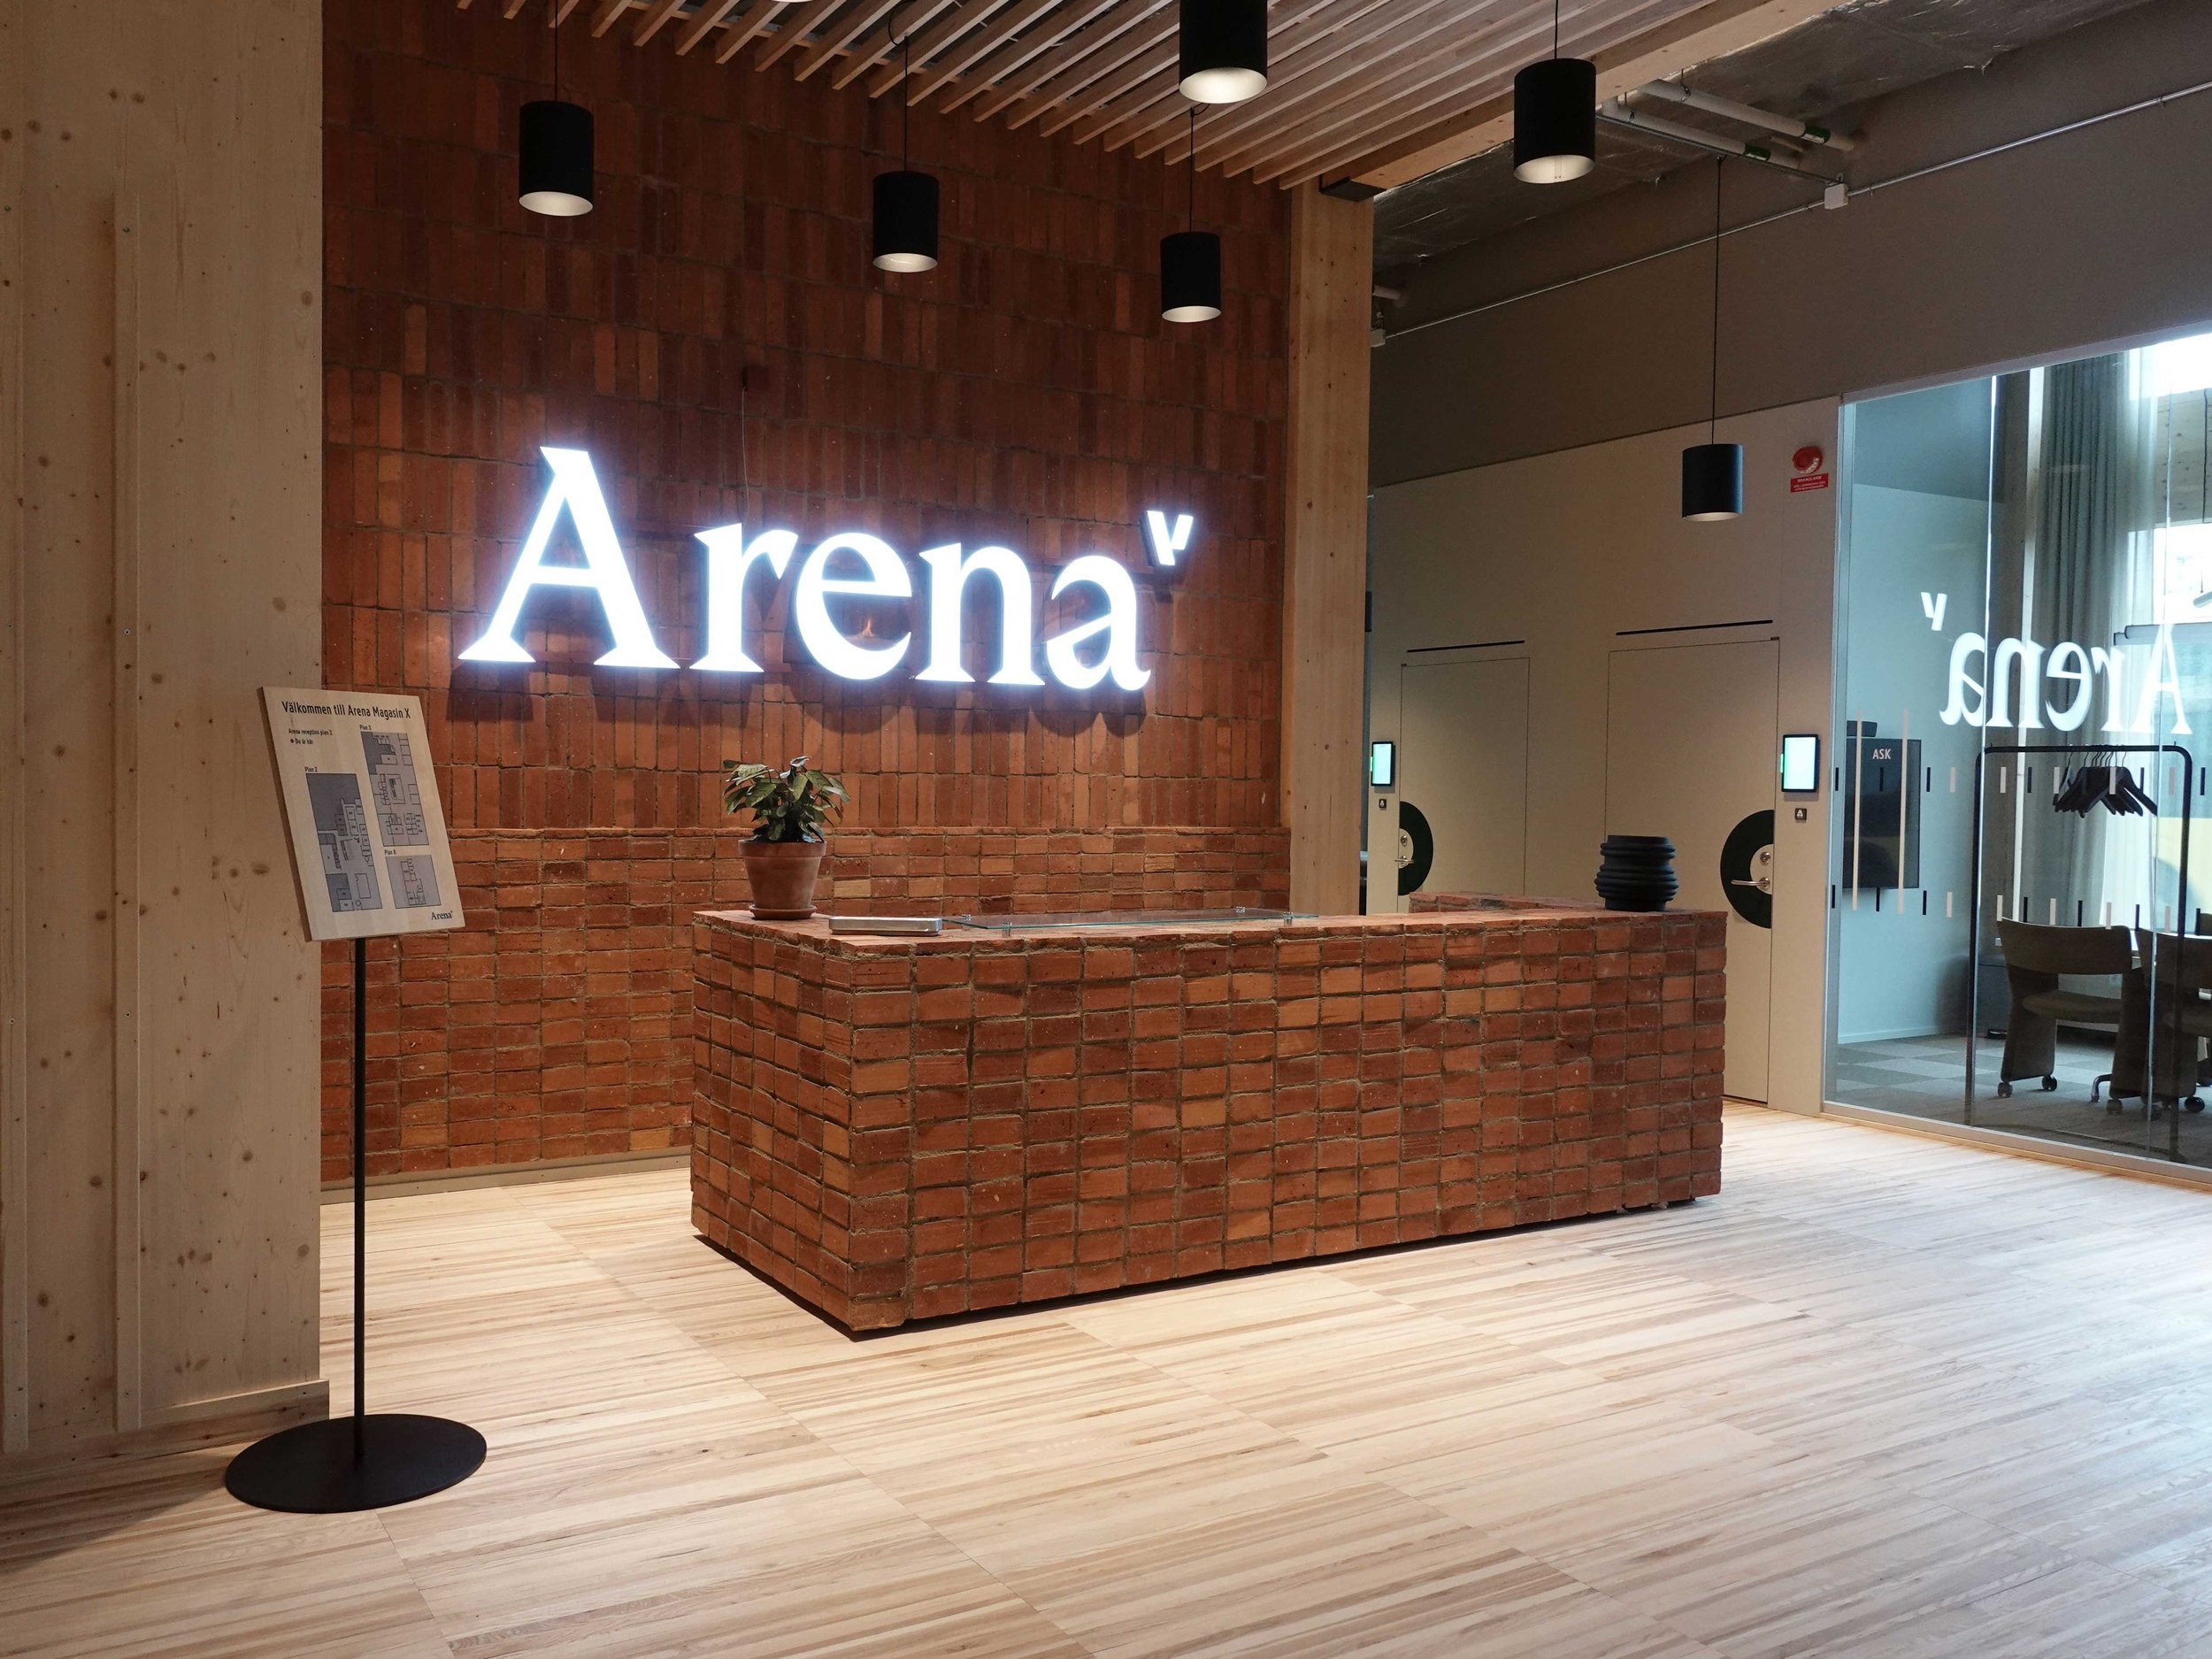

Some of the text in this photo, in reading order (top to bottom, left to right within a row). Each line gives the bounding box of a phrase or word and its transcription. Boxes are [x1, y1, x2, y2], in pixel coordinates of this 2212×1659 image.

[457, 446, 1151, 692] Arena
[281, 701, 411, 720] Välkommen till Arena Magasin X
[1872, 749, 1892, 760] ASK
